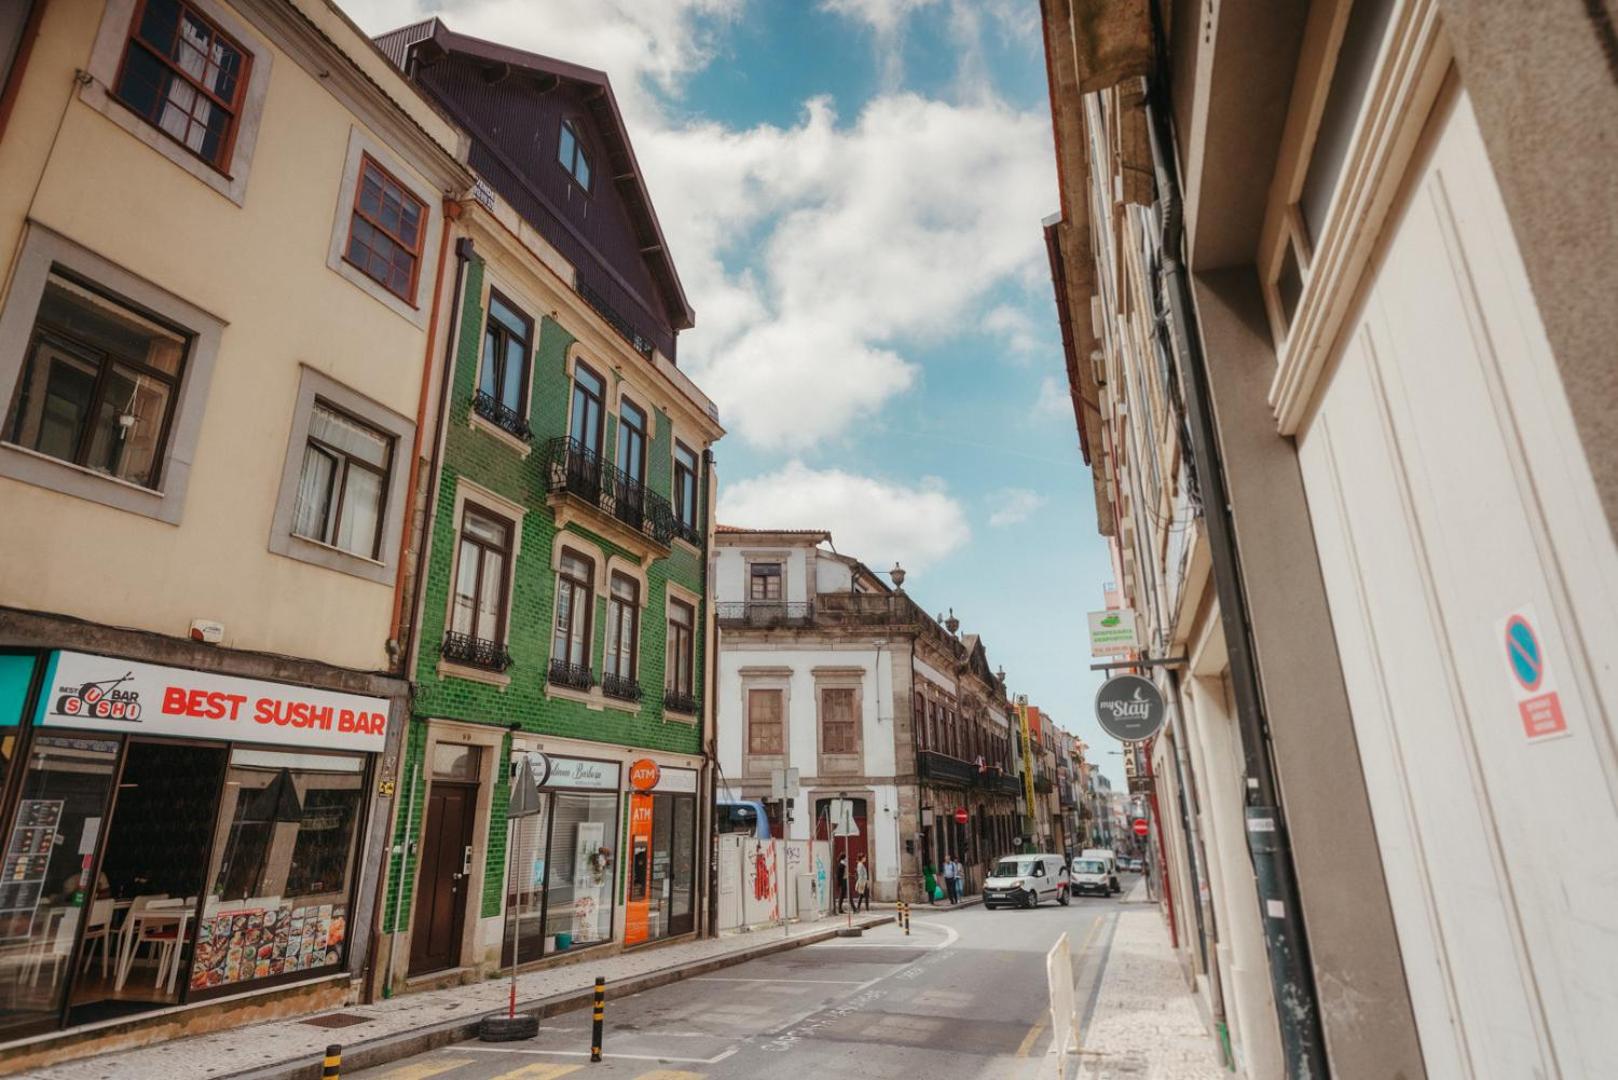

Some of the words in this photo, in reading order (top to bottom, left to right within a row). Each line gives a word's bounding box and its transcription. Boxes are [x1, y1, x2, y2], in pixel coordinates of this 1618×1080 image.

[67, 687, 137, 717] SUSHI
[112, 690, 139, 703] BAR
[162, 687, 247, 720] BEST
[254, 698, 333, 731] SUSHI
[338, 709, 386, 735] BAR
[632, 769, 656, 779] ATM
[632, 808, 651, 821] ATM
